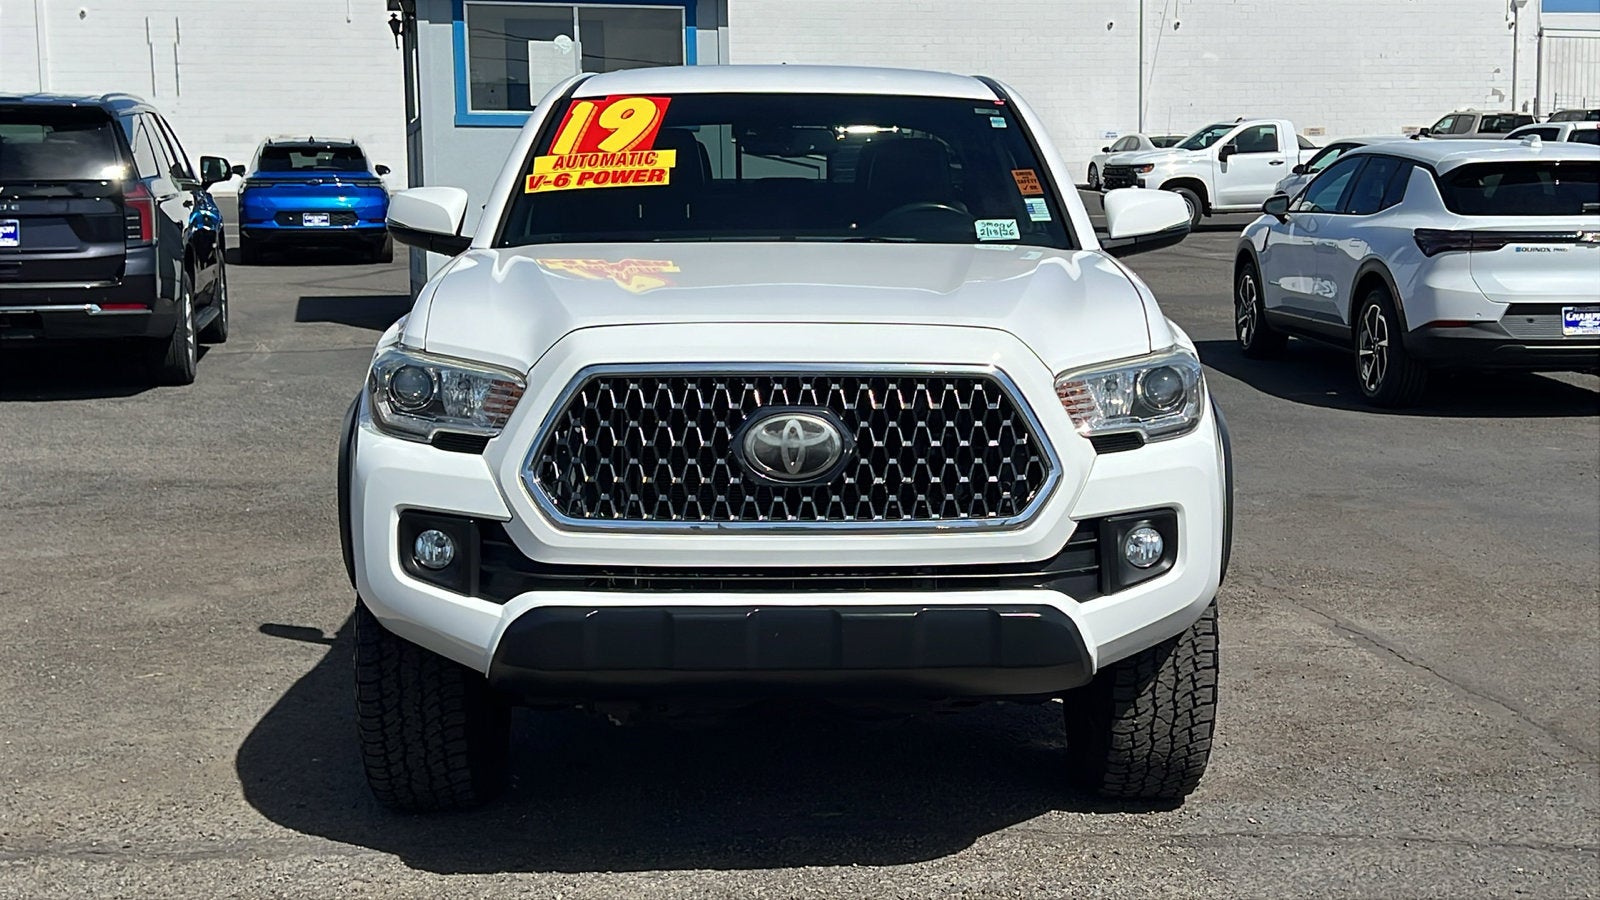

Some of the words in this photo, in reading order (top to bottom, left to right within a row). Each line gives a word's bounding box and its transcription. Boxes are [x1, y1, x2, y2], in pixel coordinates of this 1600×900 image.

[552, 97, 660, 154] 19
[552, 151, 658, 170] AUTOMATIC
[528, 172, 571, 190] V-6
[576, 168, 666, 186] POWER
